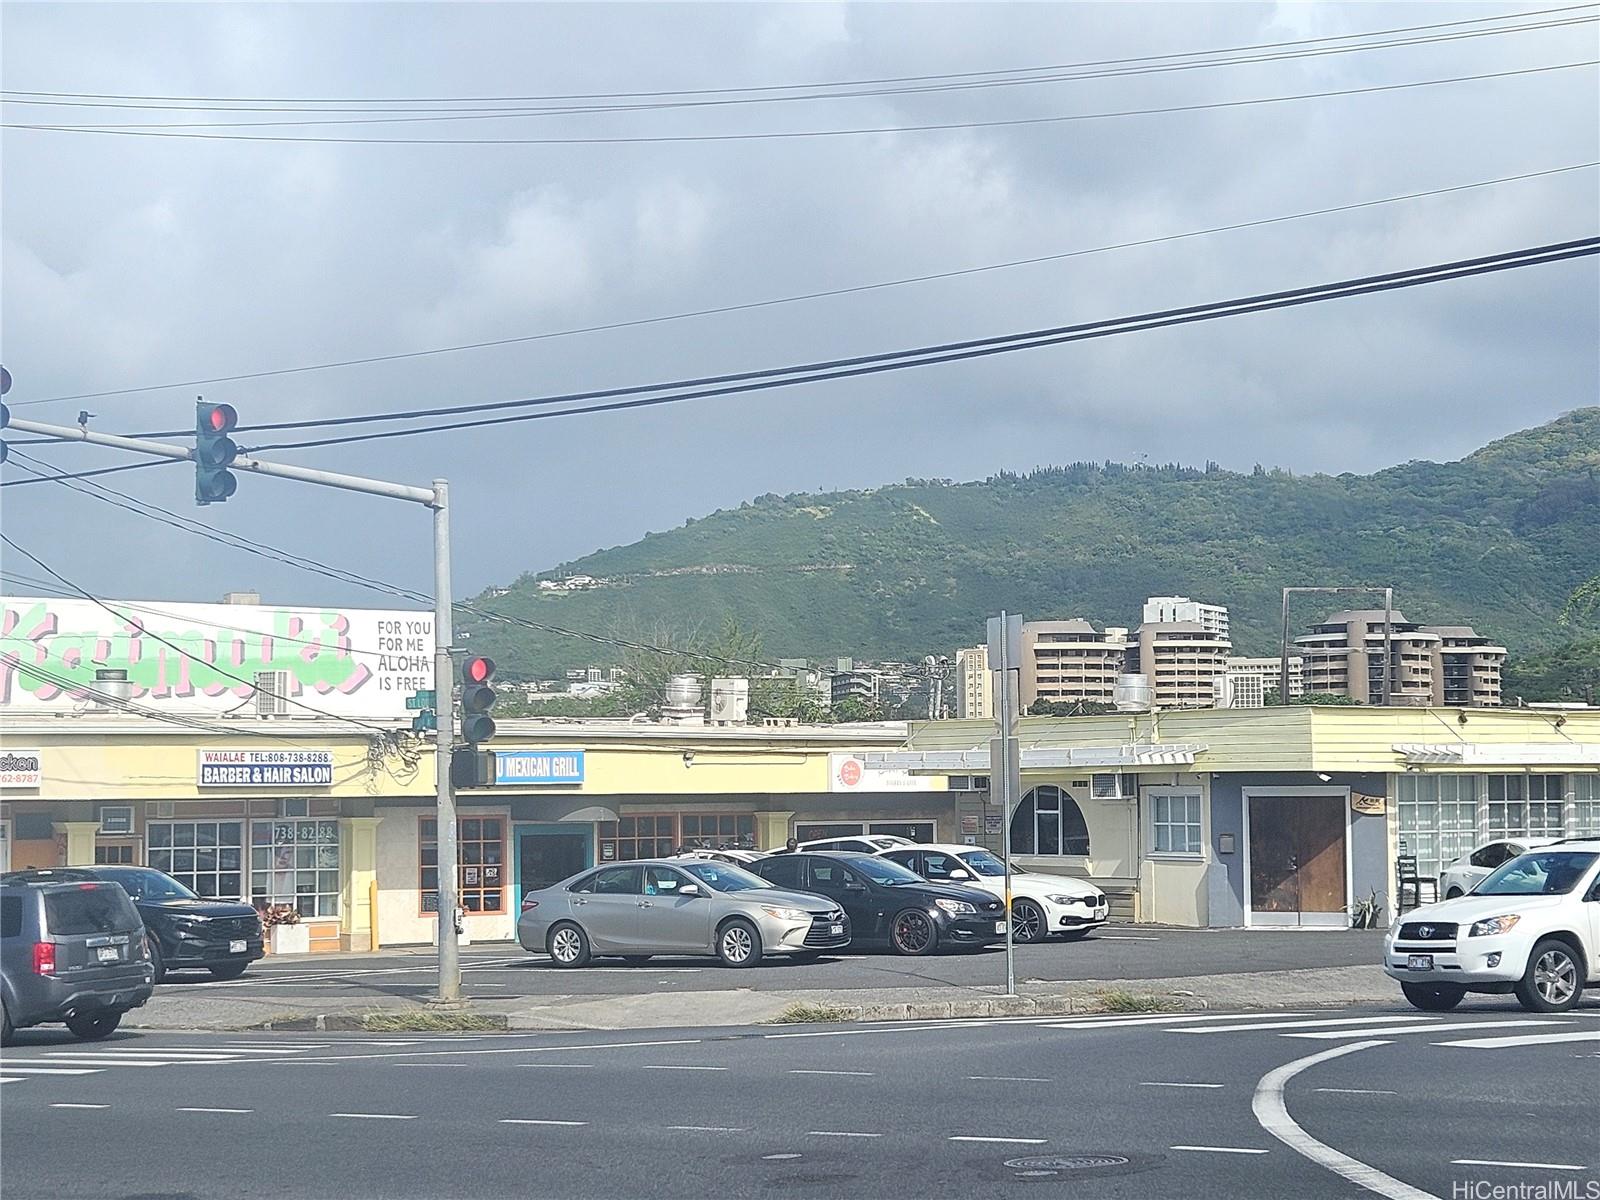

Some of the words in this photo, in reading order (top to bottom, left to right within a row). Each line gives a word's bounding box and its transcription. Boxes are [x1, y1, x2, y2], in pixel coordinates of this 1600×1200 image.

[378, 621, 402, 635] FOR
[406, 621, 431, 635] YOU
[379, 637, 403, 652] FOR
[406, 638, 424, 652] ME
[378, 655, 430, 672] ALOHA
[380, 676, 392, 691] IS
[396, 677, 426, 691] FREE
[205, 752, 246, 763] WAIALAE
[203, 766, 251, 783] BARBER
[252, 767, 262, 783] &
[263, 767, 291, 783] HAIR
[293, 766, 330, 783] SALON
[506, 757, 550, 777] MEXICAN
[553, 757, 579, 777] GRILL
[0, 774, 38, 783] 62-8787
